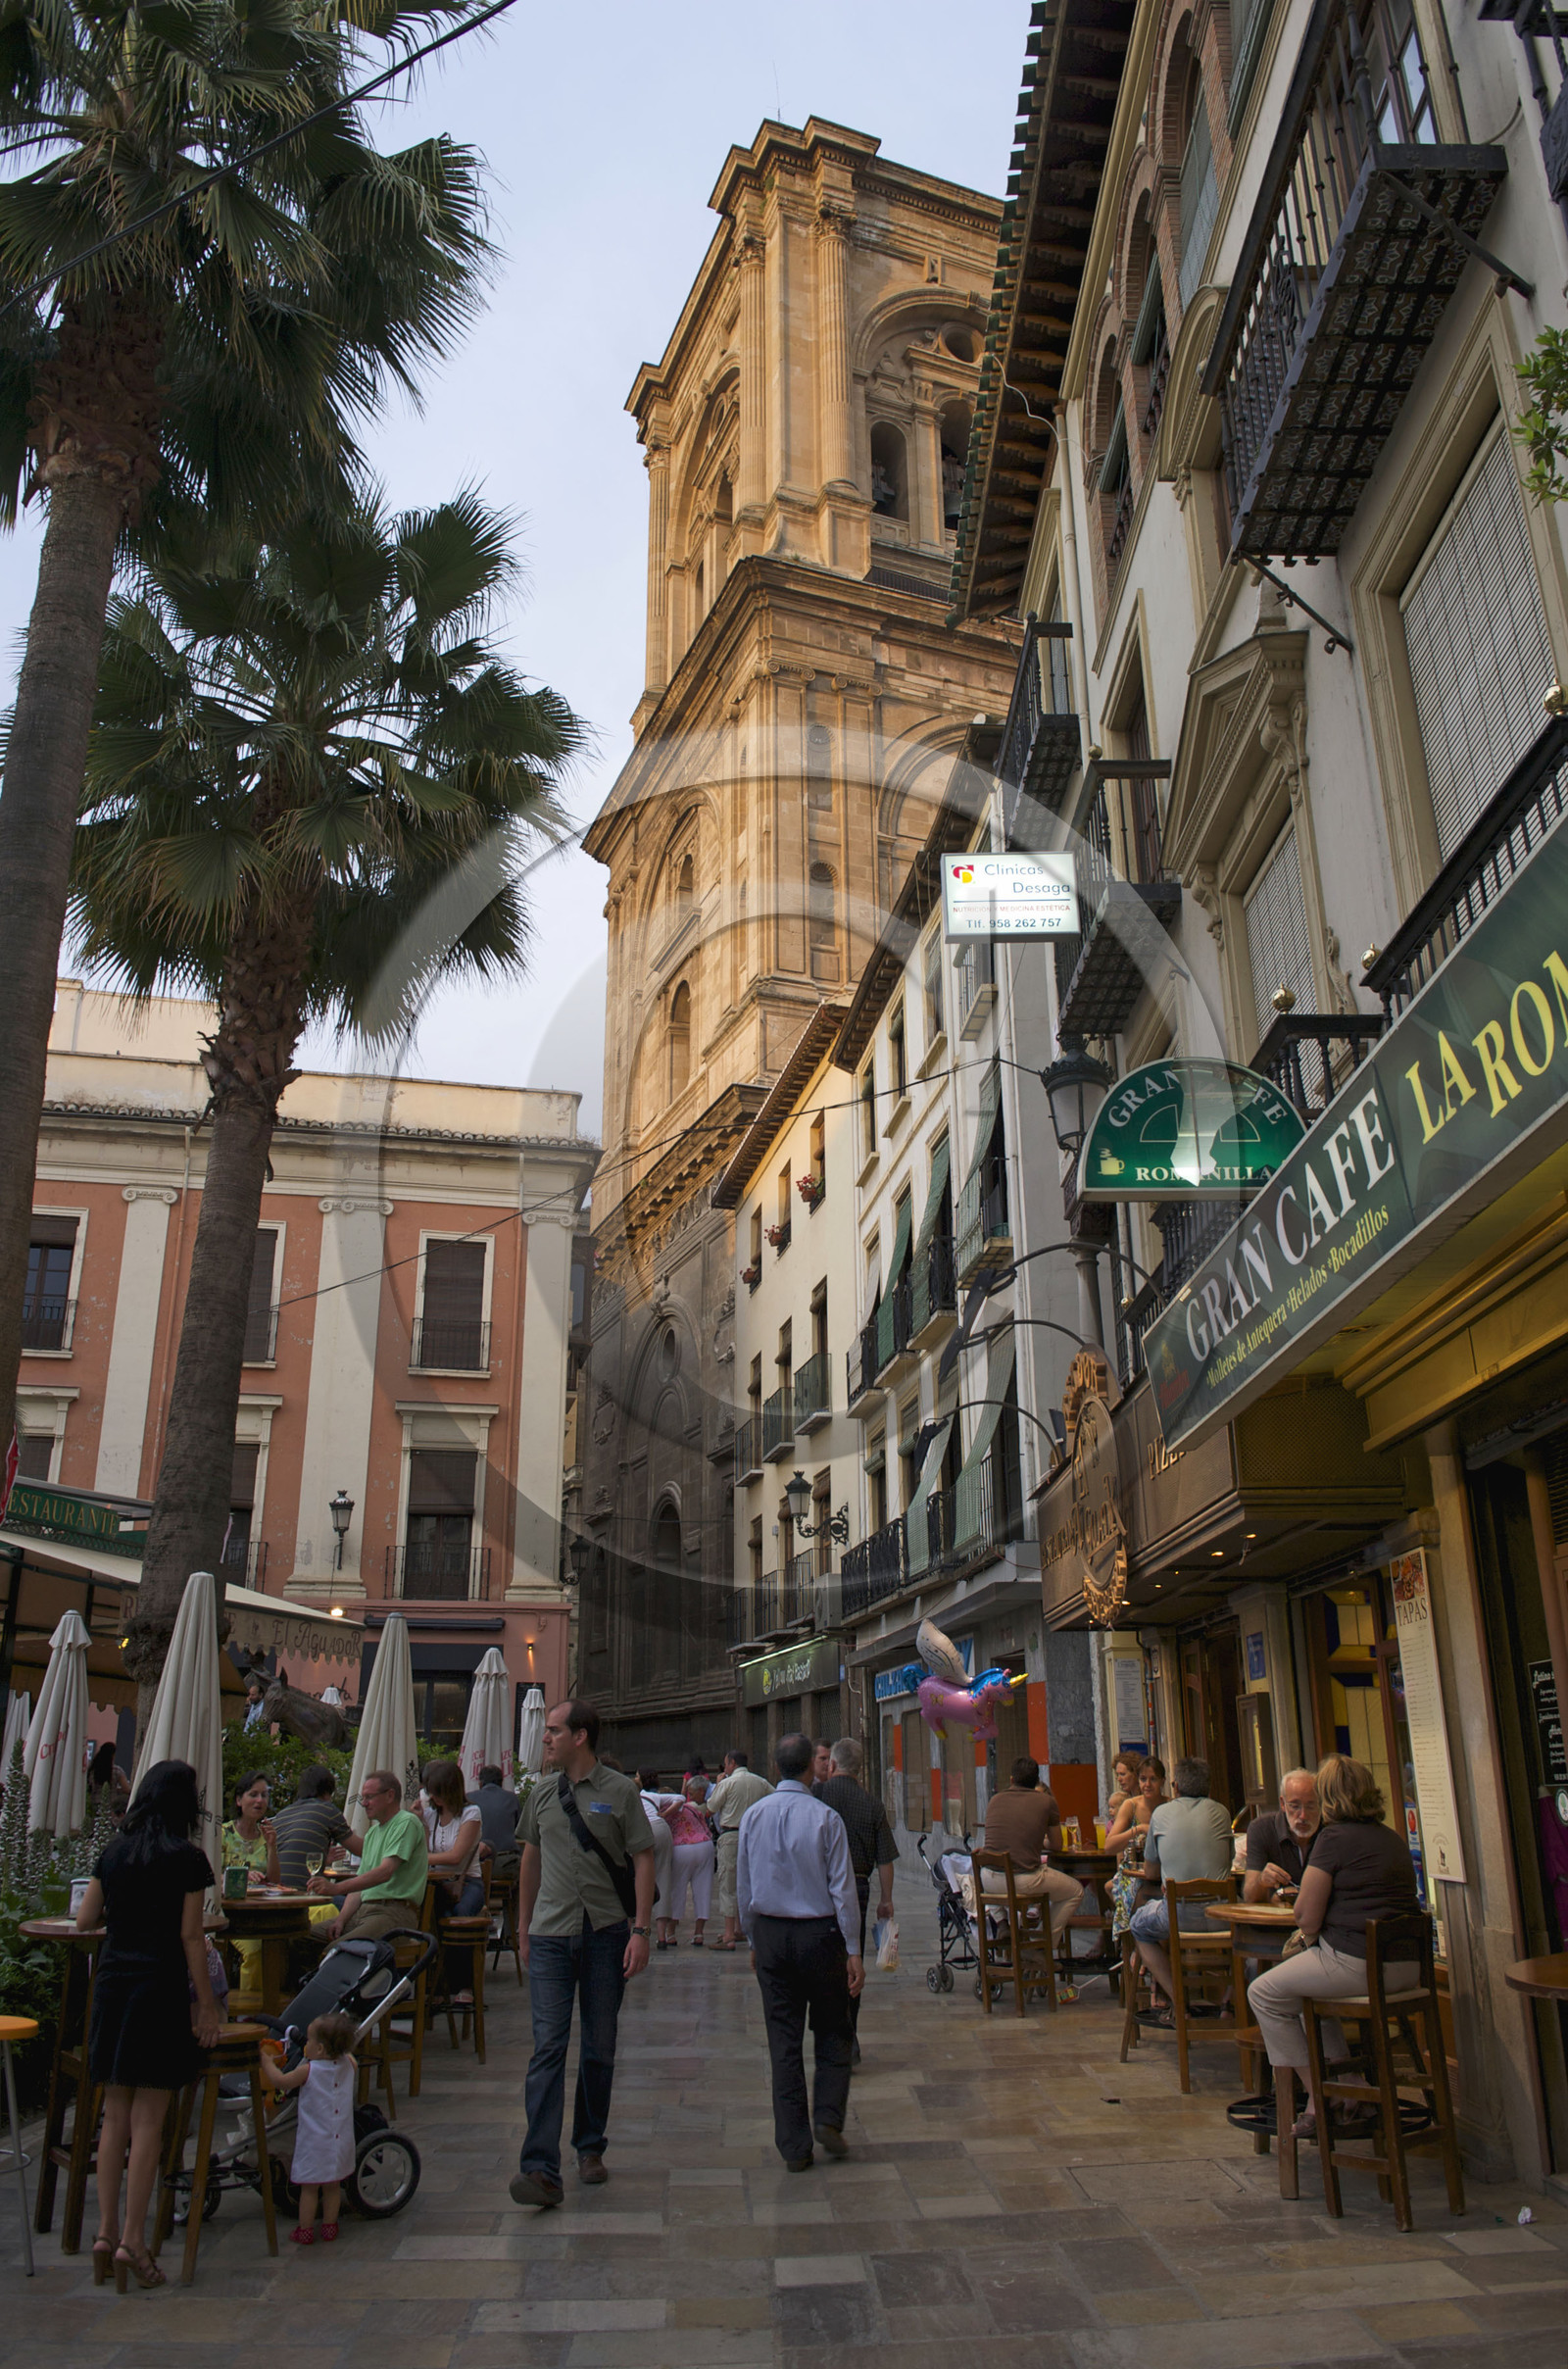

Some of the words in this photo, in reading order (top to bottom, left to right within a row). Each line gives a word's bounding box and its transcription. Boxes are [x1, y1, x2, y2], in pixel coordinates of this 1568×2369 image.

[1013, 882, 1070, 895] Desaga
[989, 919, 1010, 929] 958
[1015, 918, 1036, 928] 262
[1040, 917, 1060, 927] 757
[1186, 1222, 1274, 1362] GRAN
[1275, 1088, 1396, 1266] CAFE
[1237, 1340, 1248, 1363] de
[1246, 1304, 1288, 1356] Antequera
[1396, 1597, 1428, 1627] TAPAS
[272, 1618, 290, 1647] El
